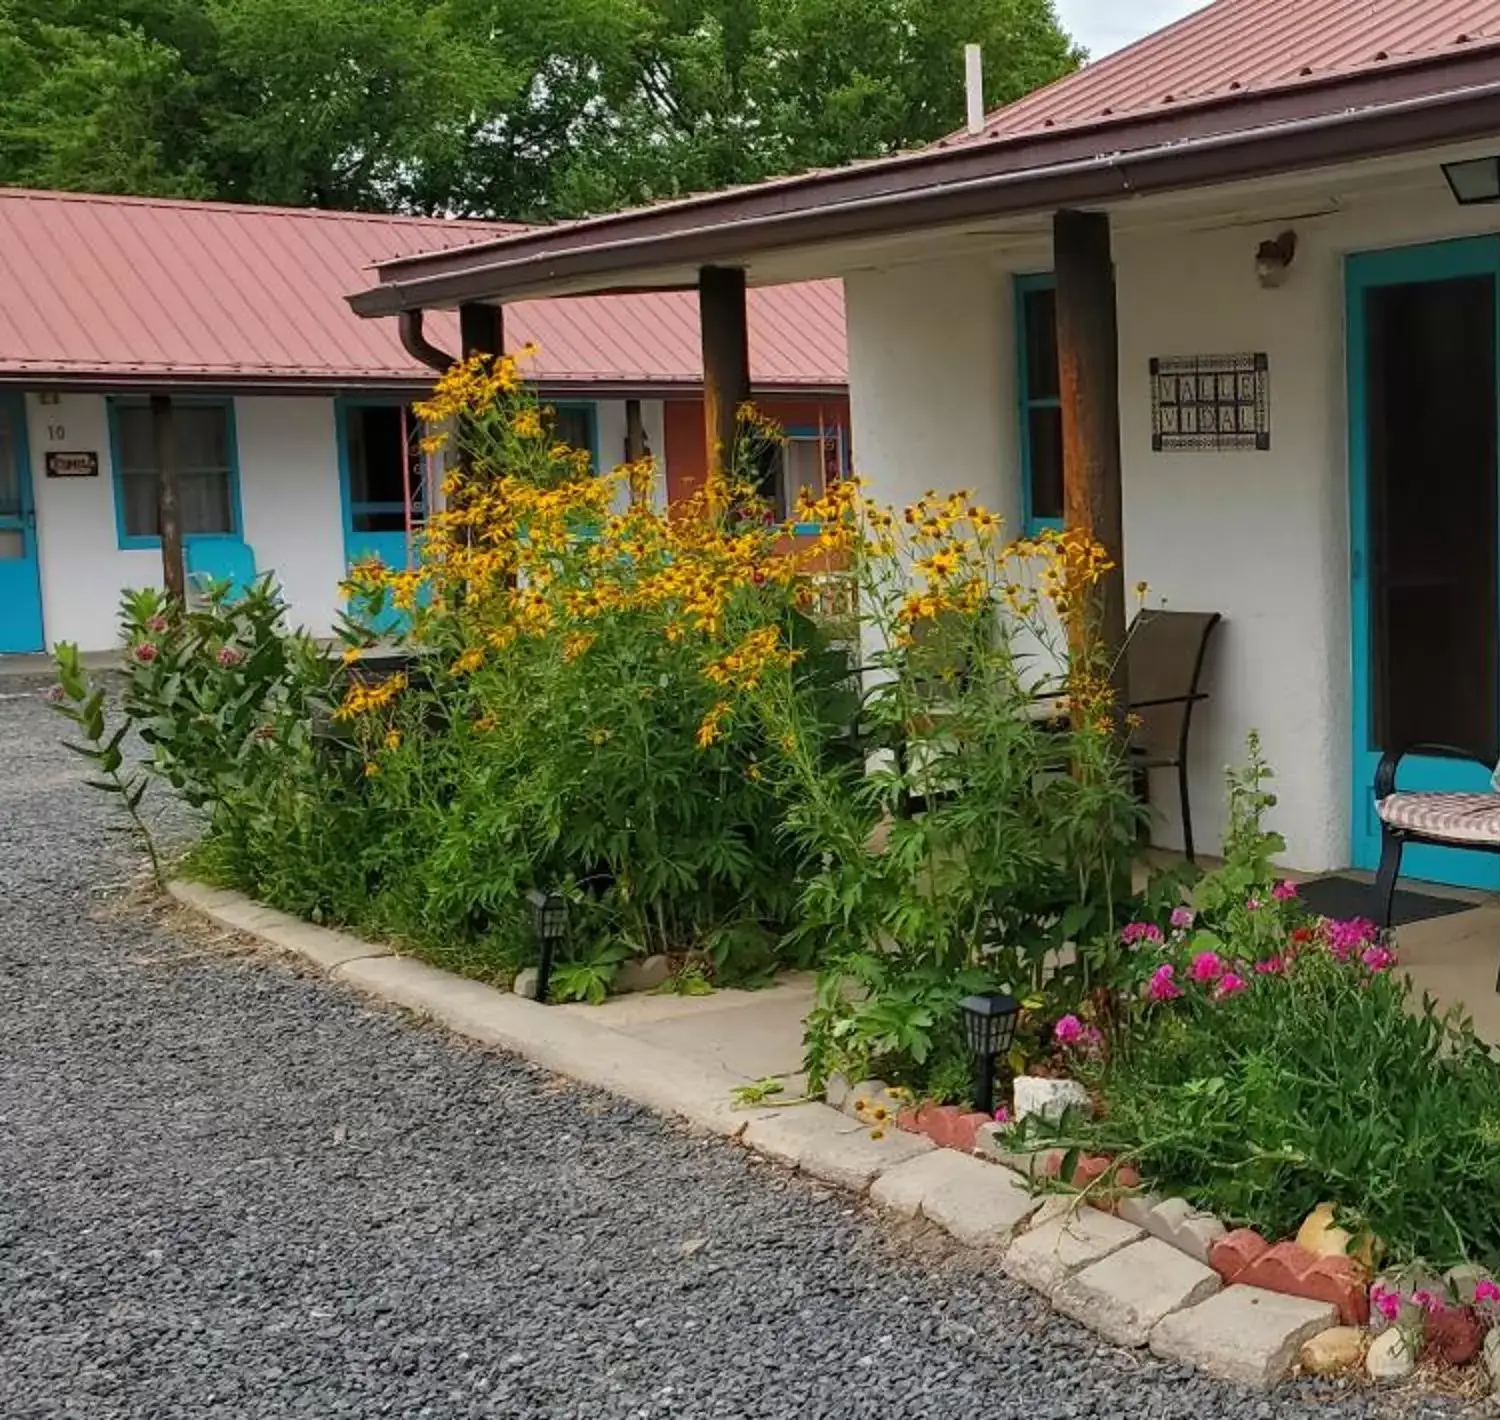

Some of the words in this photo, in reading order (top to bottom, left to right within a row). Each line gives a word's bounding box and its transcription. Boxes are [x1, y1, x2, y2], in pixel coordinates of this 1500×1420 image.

[1162, 375, 1252, 401] VALLE
[1162, 406, 1253, 430] VIDAL
[47, 425, 65, 440] 10
